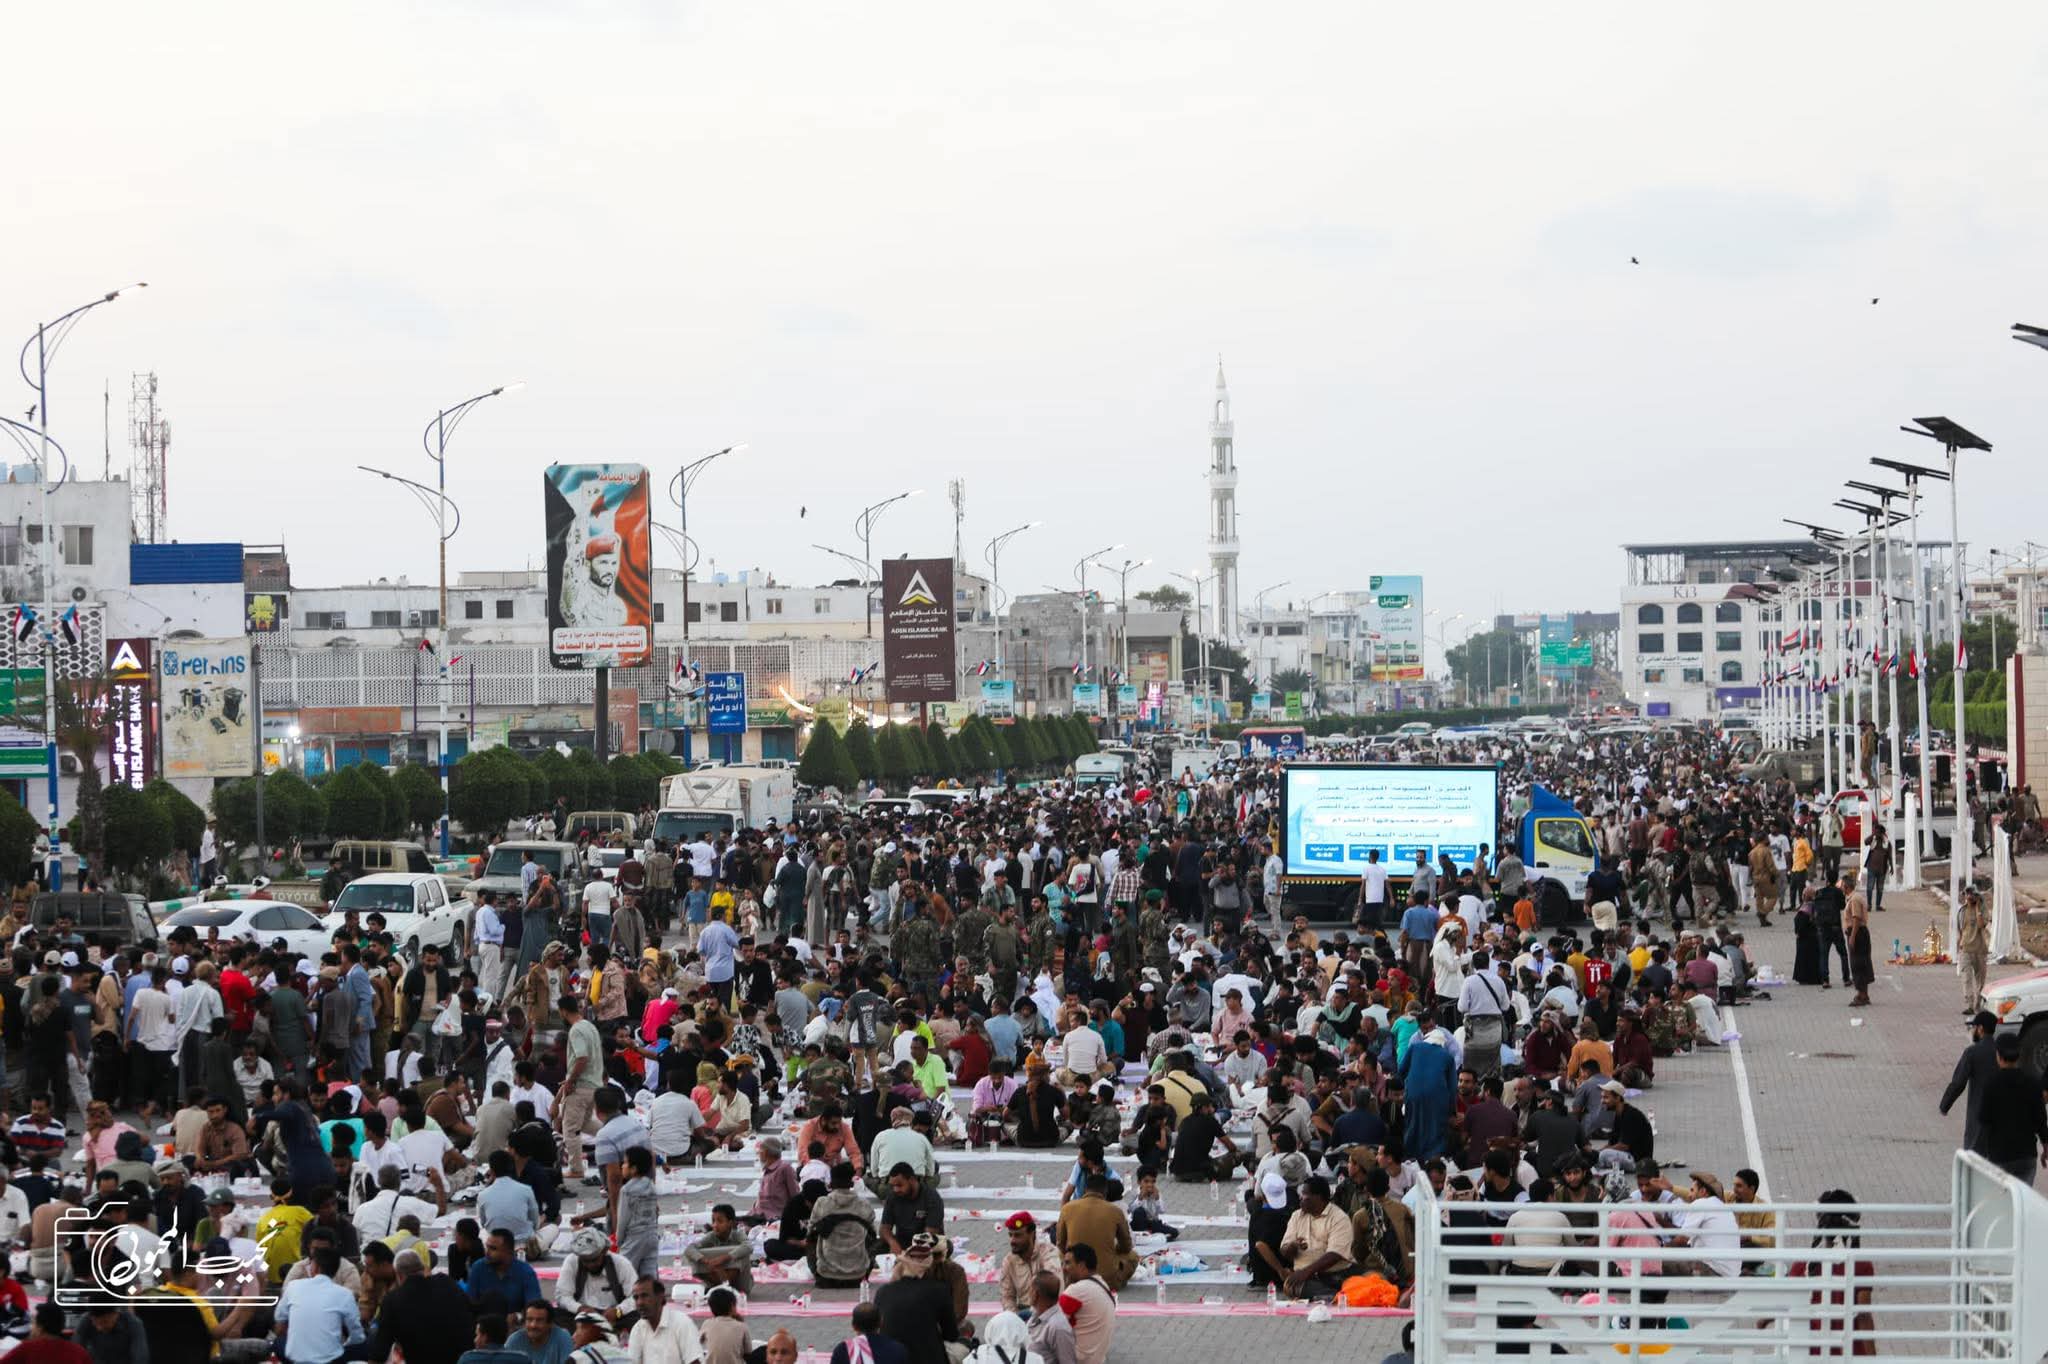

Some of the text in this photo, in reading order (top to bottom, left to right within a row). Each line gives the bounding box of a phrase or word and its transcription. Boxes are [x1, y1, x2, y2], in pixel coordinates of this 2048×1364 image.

[130, 723, 144, 770] ISLAMIC
[272, 891, 318, 901] TOYOTA
[1590, 967, 1601, 983] 11
